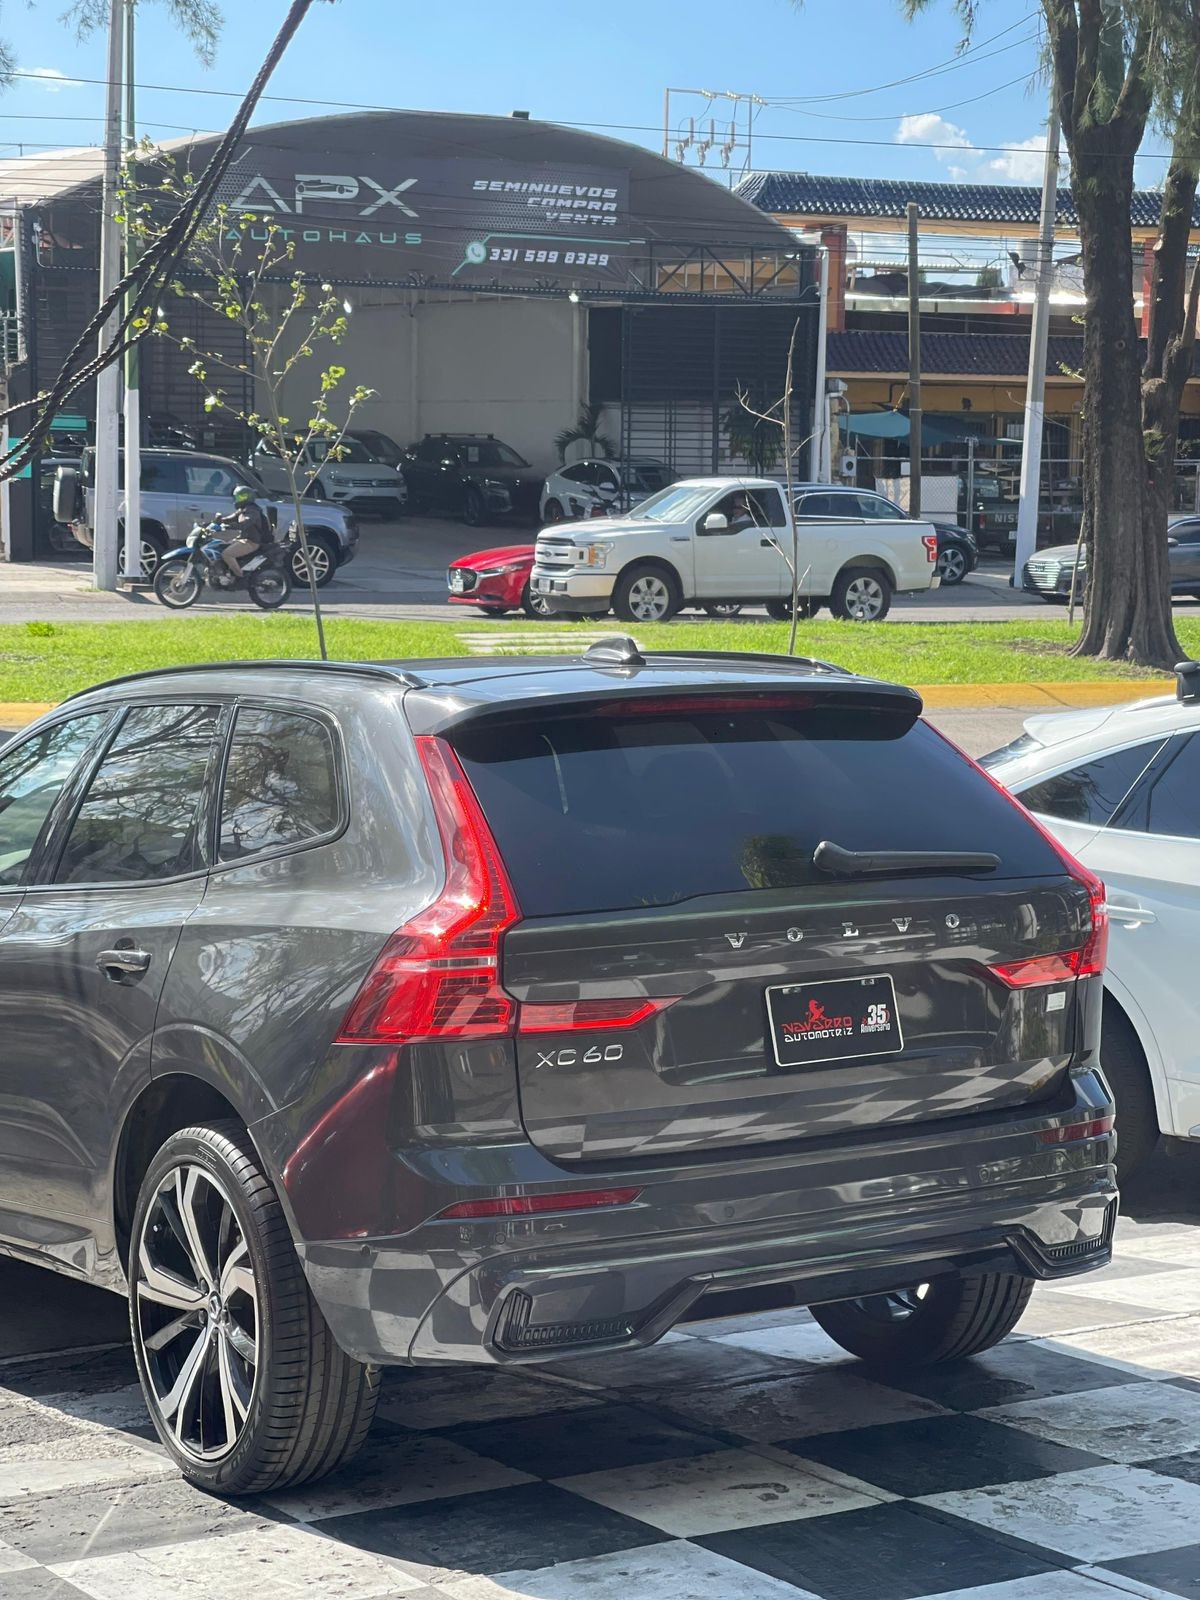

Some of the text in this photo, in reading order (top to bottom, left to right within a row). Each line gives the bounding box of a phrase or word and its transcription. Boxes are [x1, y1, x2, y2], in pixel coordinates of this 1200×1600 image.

[227, 173, 420, 218] APX
[472, 180, 618, 199] SEMINUEVOS
[526, 197, 618, 212] COMPRA
[544, 211, 618, 226] VENTA
[225, 228, 423, 245] AUTOHAUS
[489, 248, 609, 267] 331 599 8329
[724, 913, 960, 949] VOLVO
[866, 1003, 887, 1025] 35
